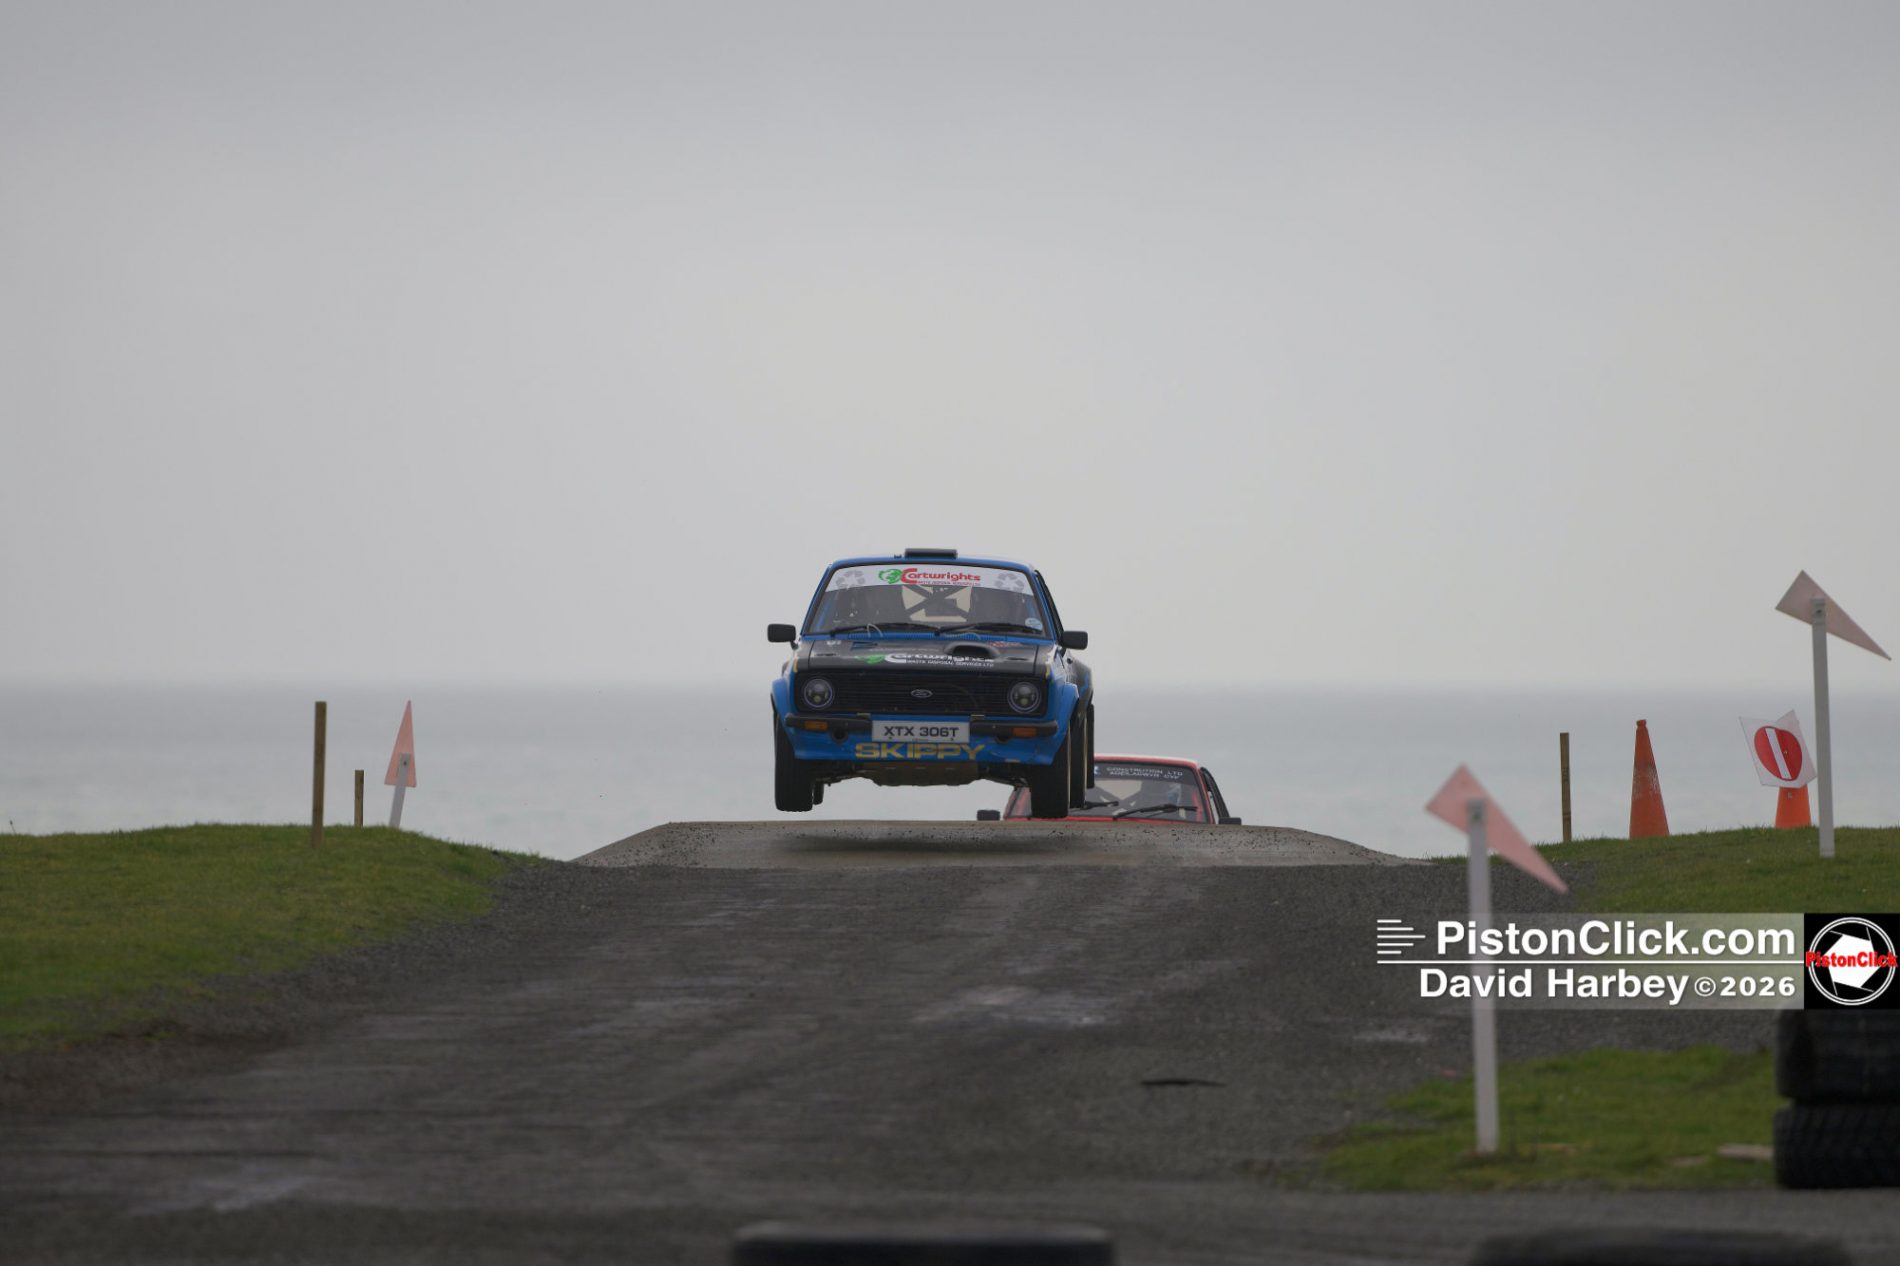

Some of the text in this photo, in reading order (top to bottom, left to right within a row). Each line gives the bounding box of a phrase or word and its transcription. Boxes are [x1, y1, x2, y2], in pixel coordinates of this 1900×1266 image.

[901, 568, 981, 584] Cartwrights
[884, 726, 959, 737] XTX 306T
[855, 743, 985, 759] SKIPPY
